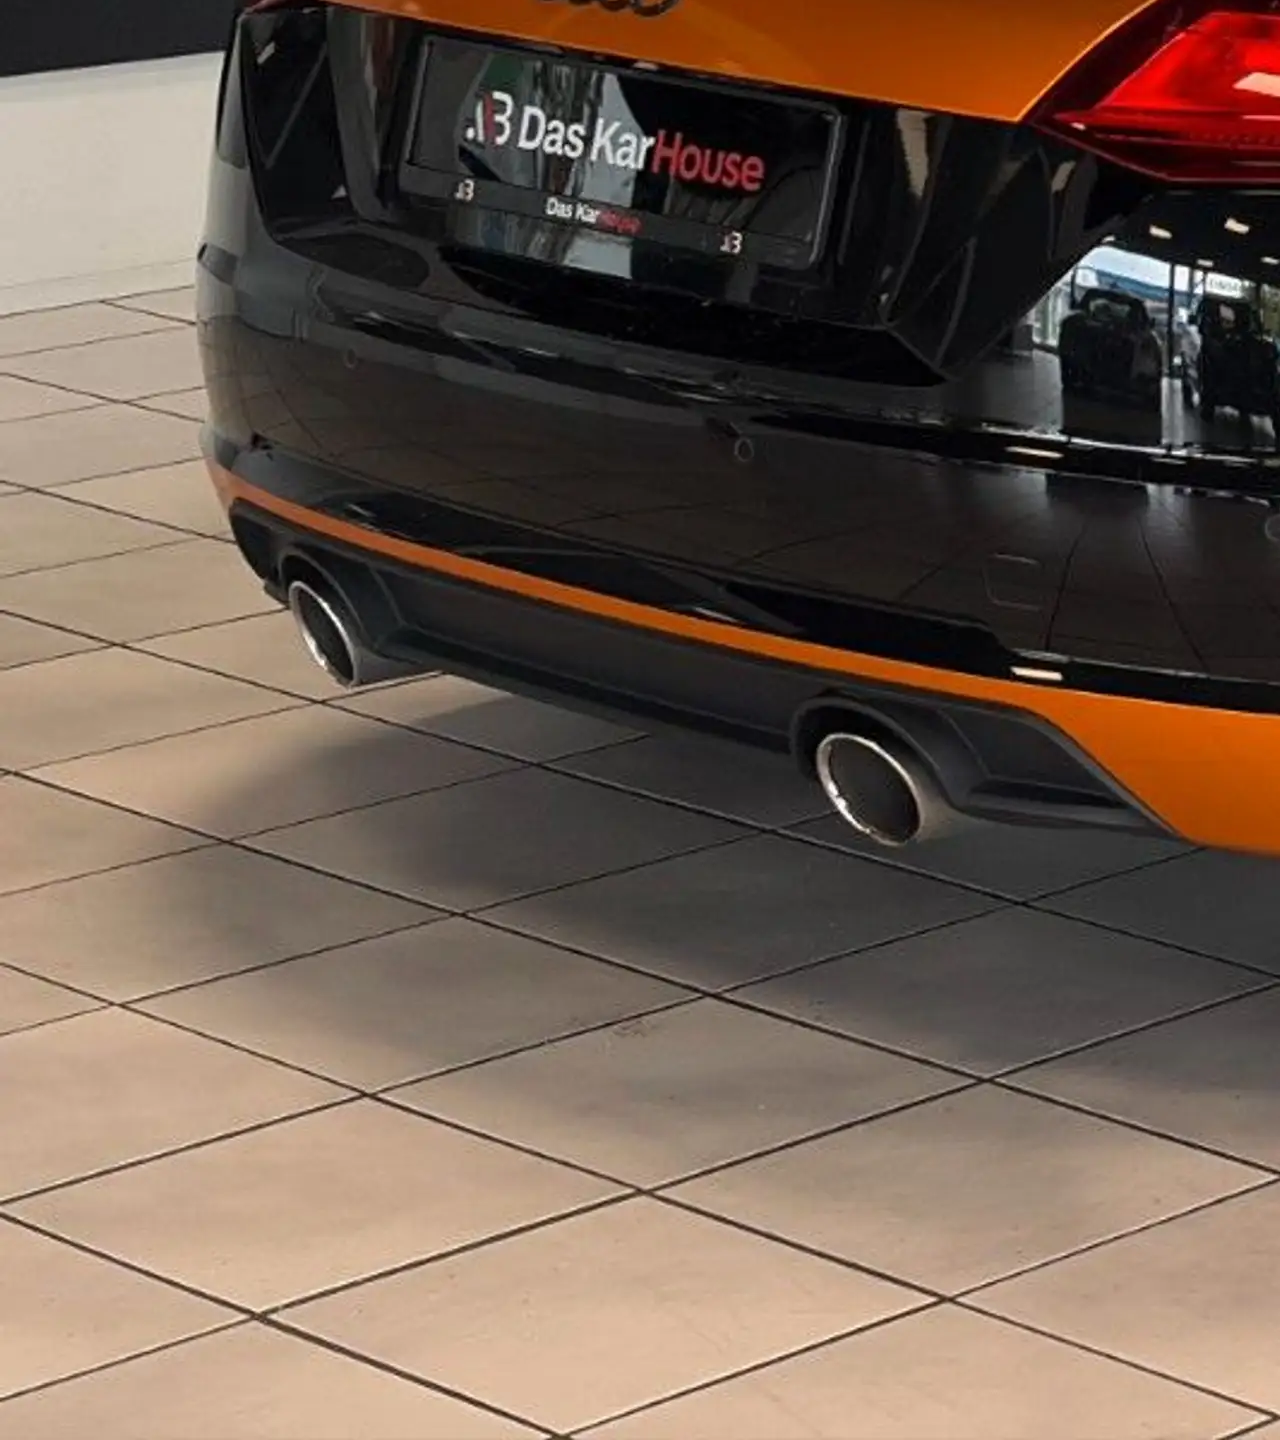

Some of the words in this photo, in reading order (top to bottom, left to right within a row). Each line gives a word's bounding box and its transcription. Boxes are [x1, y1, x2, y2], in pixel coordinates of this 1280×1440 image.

[518, 107, 586, 159] Das
[590, 118, 765, 191] KarHouse
[544, 196, 574, 218] Das
